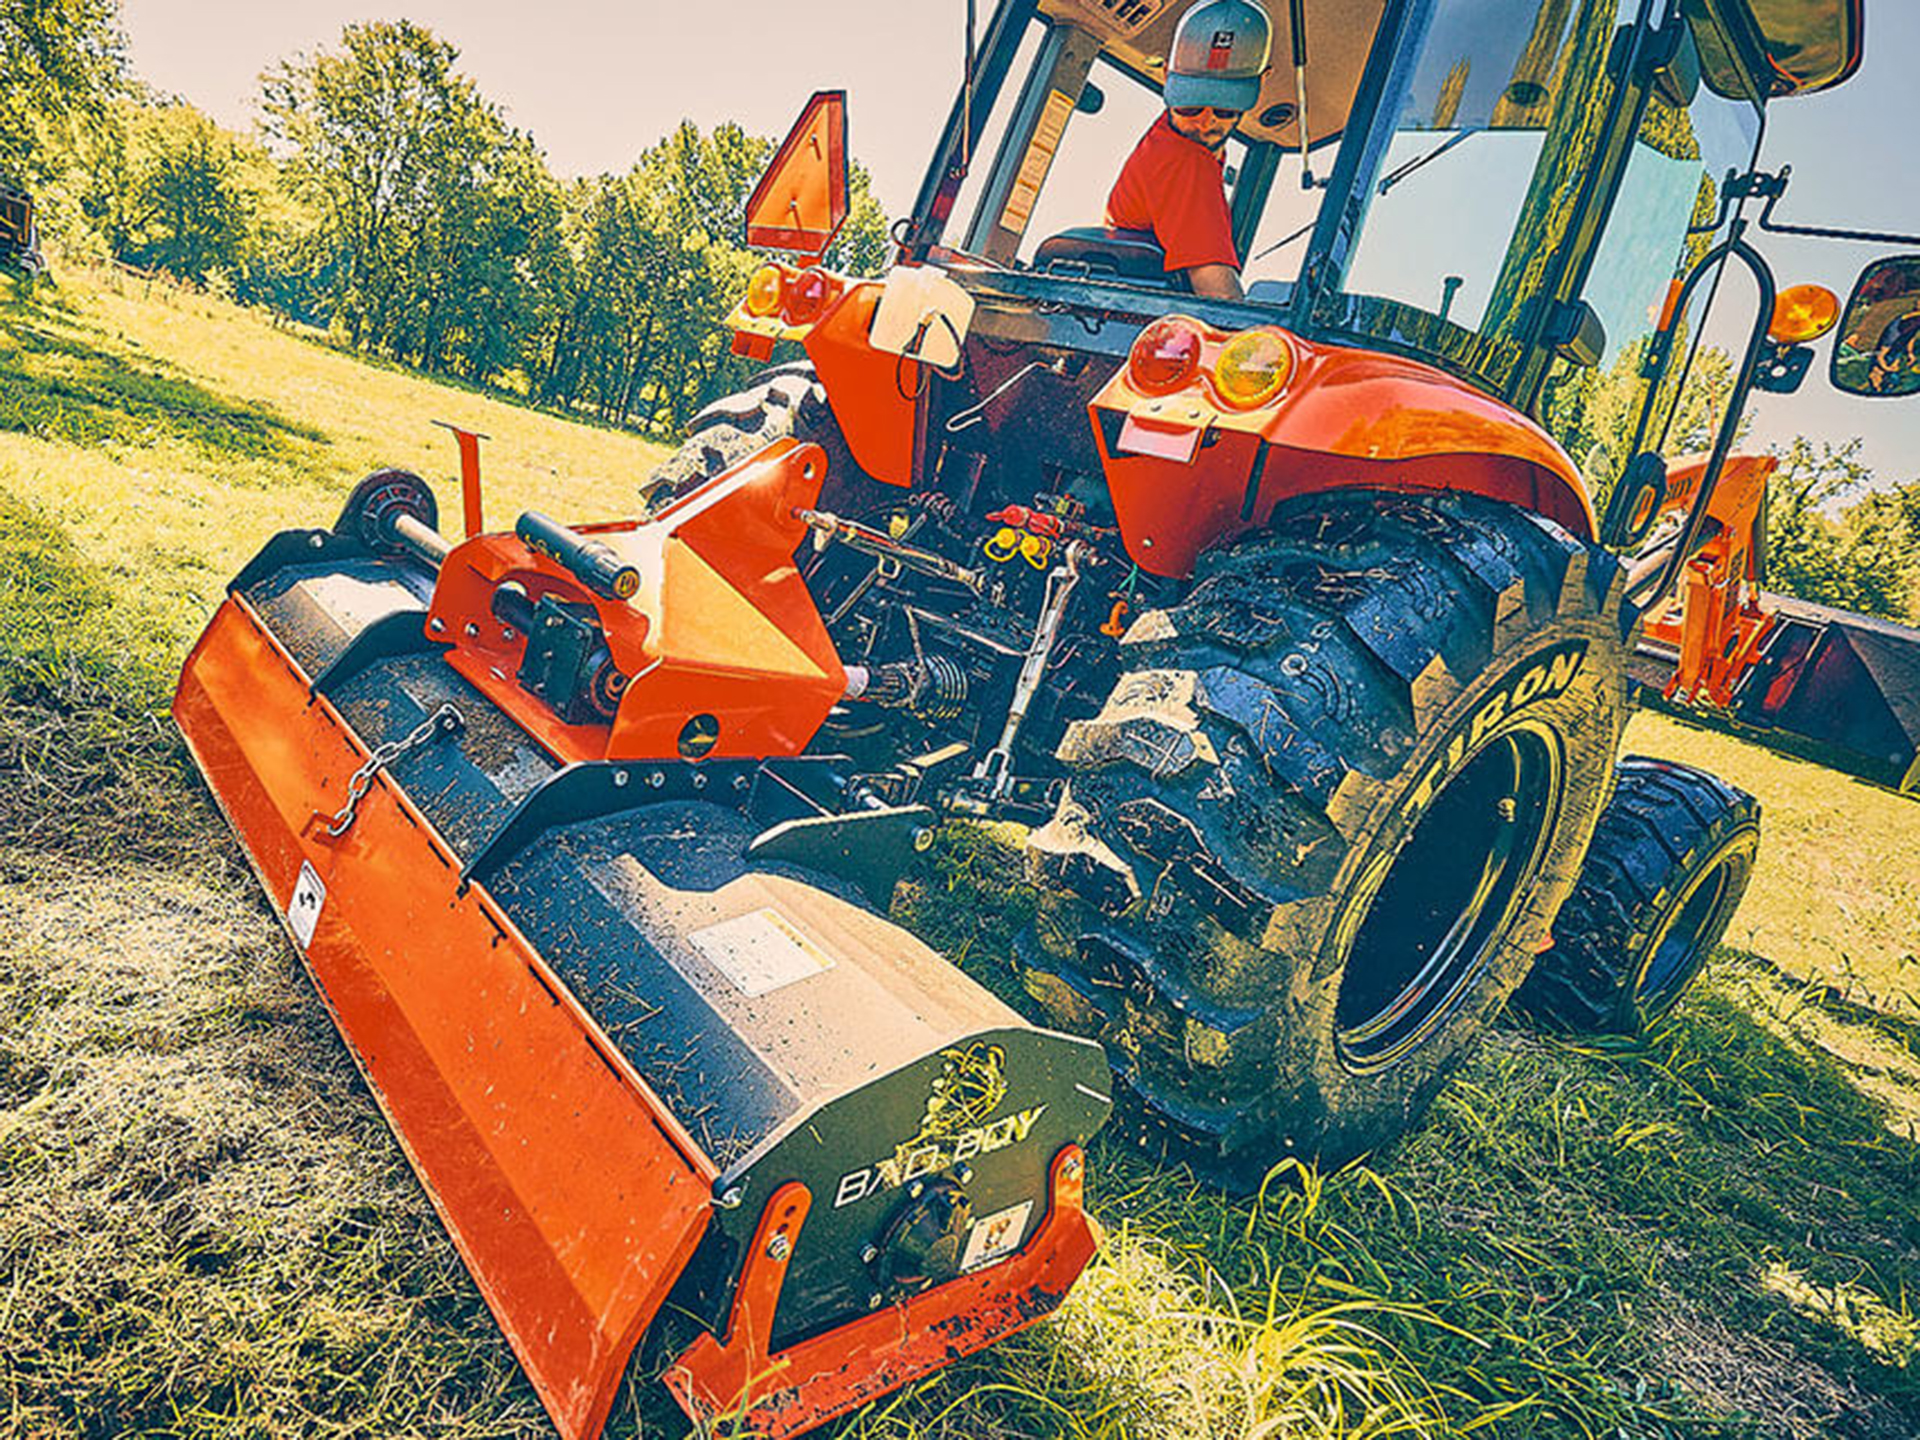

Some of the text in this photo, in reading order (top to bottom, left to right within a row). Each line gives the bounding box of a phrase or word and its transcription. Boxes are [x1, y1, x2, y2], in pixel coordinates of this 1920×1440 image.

[1401, 651, 1580, 819] TIRON
[834, 1103, 1050, 1208] BAD BOY
